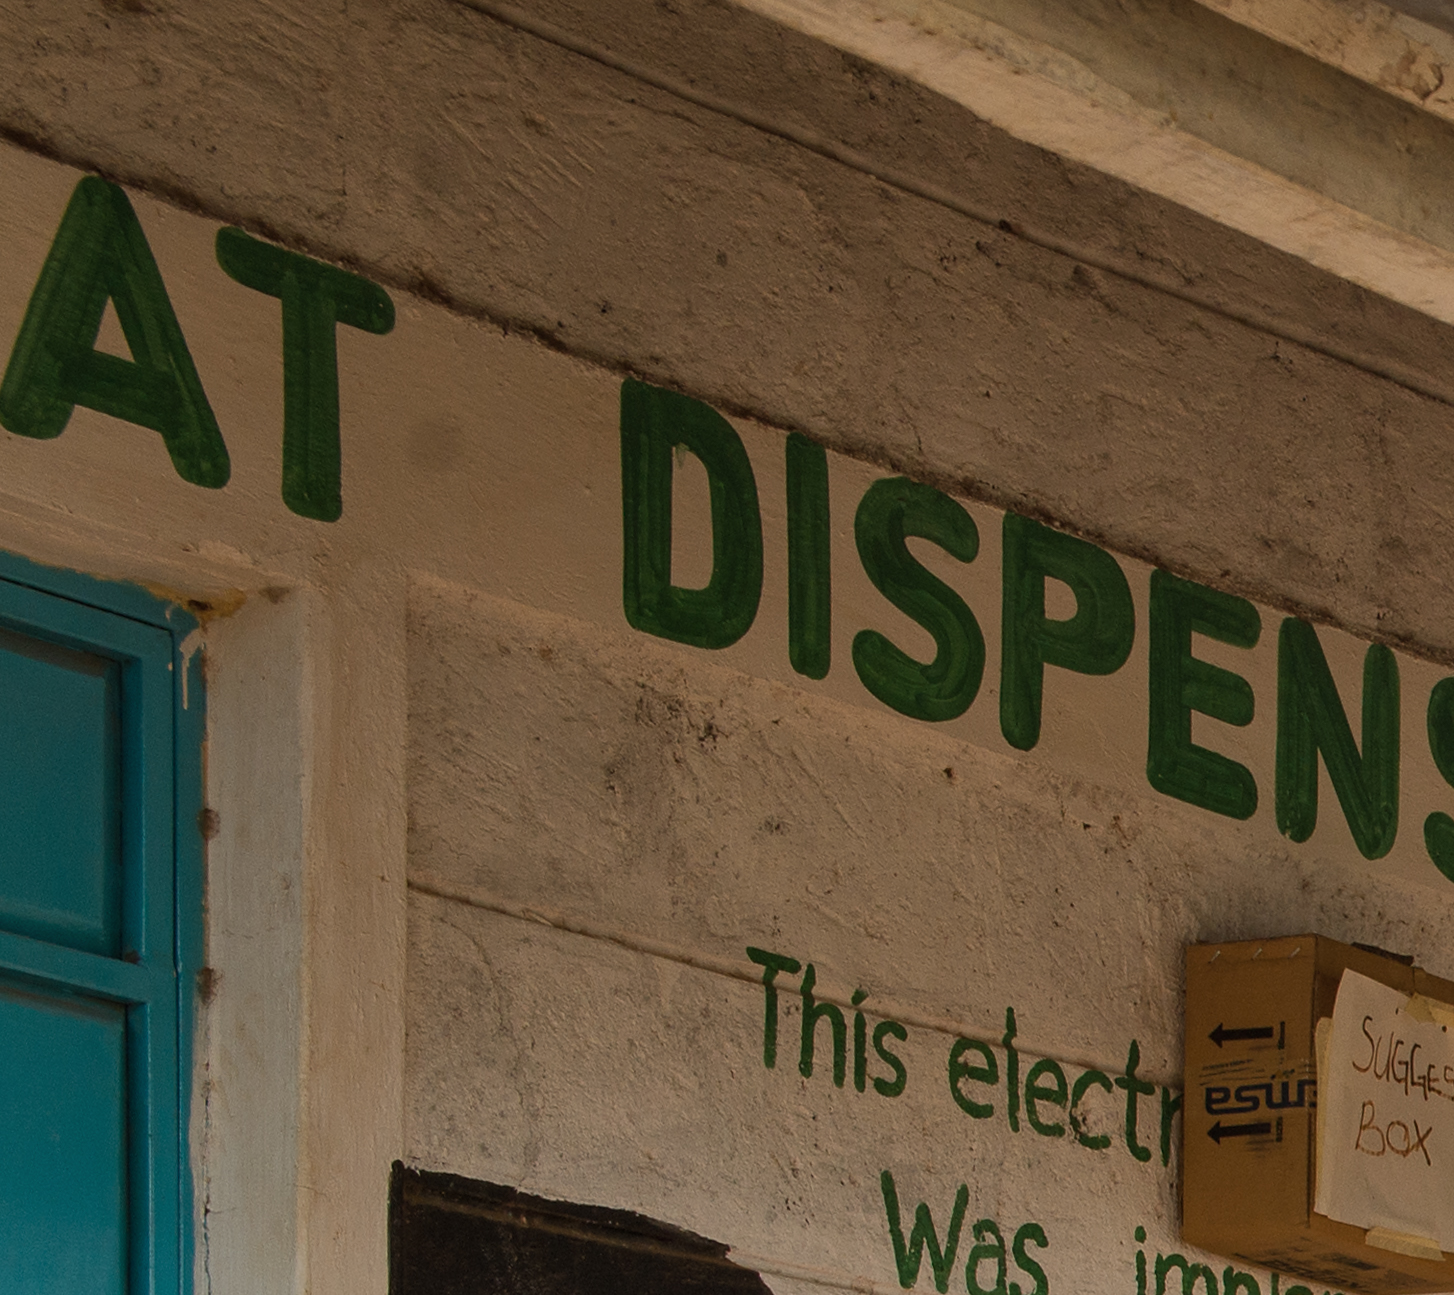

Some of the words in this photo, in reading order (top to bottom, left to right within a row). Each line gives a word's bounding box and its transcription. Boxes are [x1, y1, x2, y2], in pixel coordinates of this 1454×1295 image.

[0, 174, 394, 522] AT
[746, 946, 909, 1098] This
[948, 1006, 1183, 1168] electr
[1355, 1100, 1433, 1166] BOX
